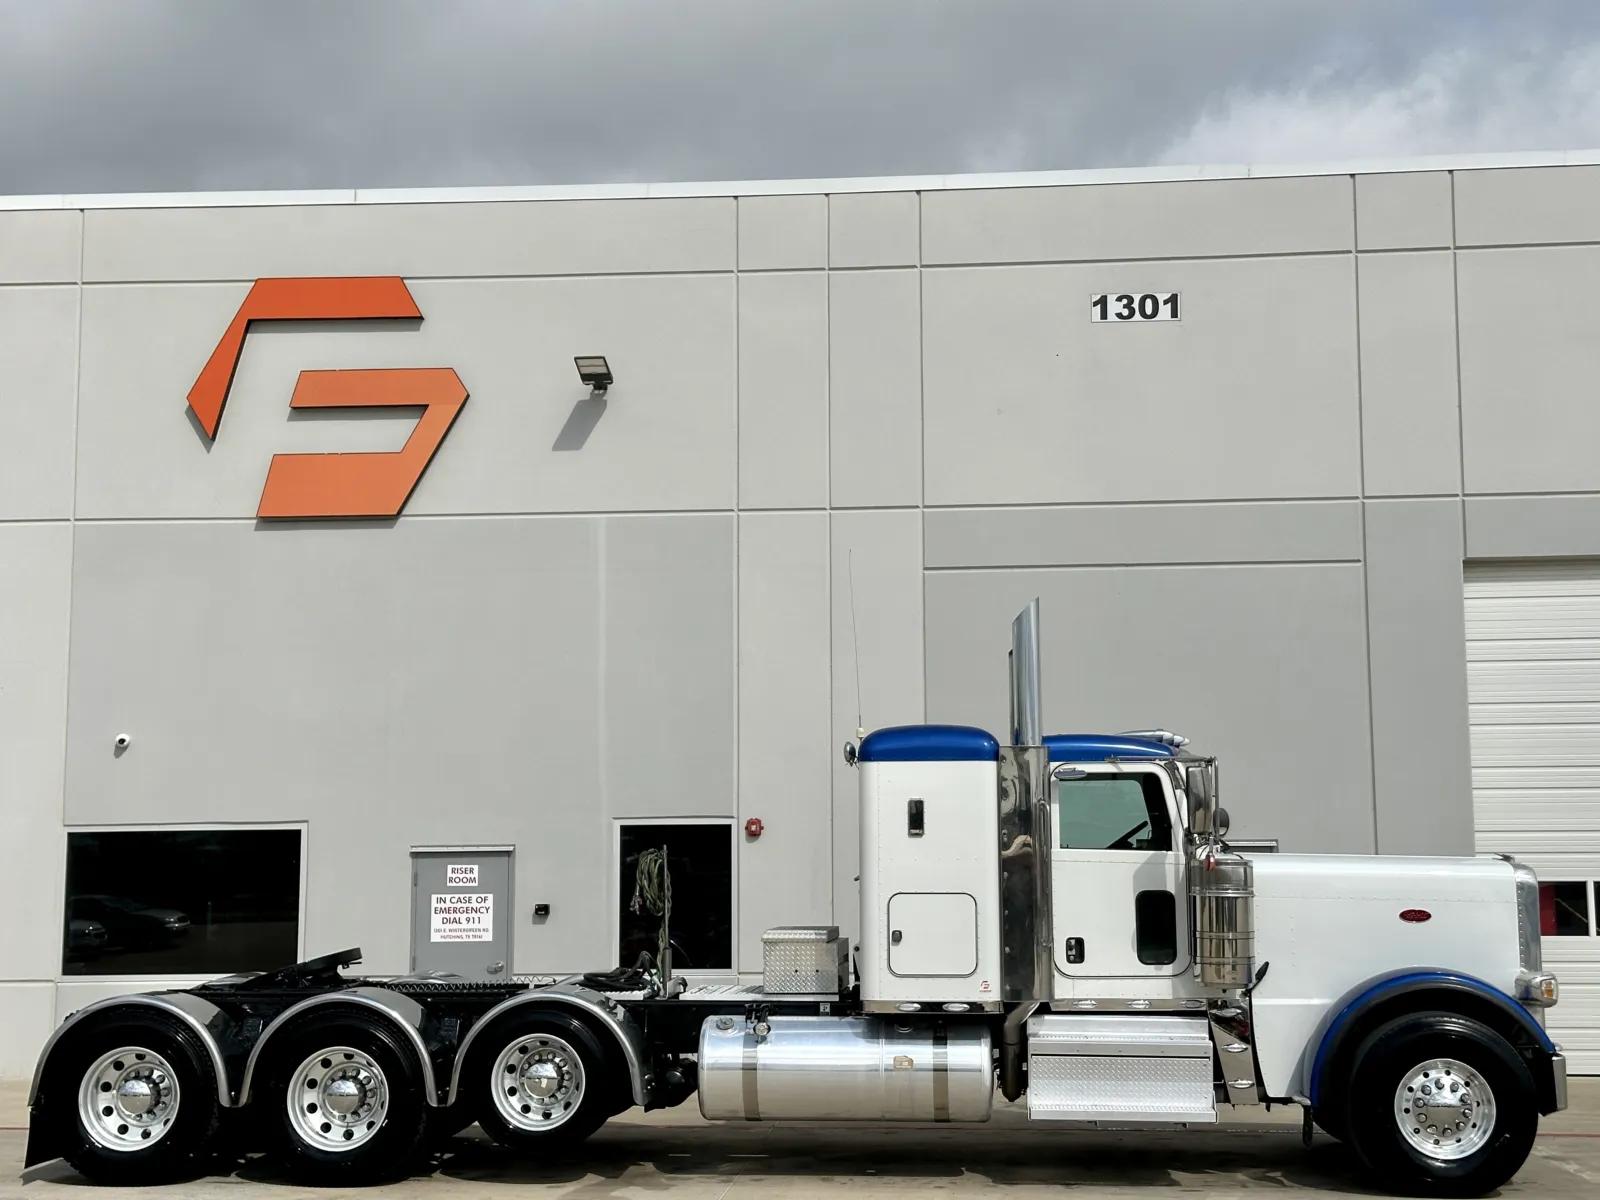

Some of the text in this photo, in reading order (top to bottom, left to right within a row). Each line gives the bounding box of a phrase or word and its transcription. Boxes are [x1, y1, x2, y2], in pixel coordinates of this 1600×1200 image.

[1092, 293, 1178, 320] 1301
[451, 866, 475, 875] RISER
[448, 876, 477, 884] ROOM
[436, 896, 489, 904] IN CASE OF
[433, 906, 491, 915] EMERGENCY
[441, 916, 481, 925] DIAL 911
